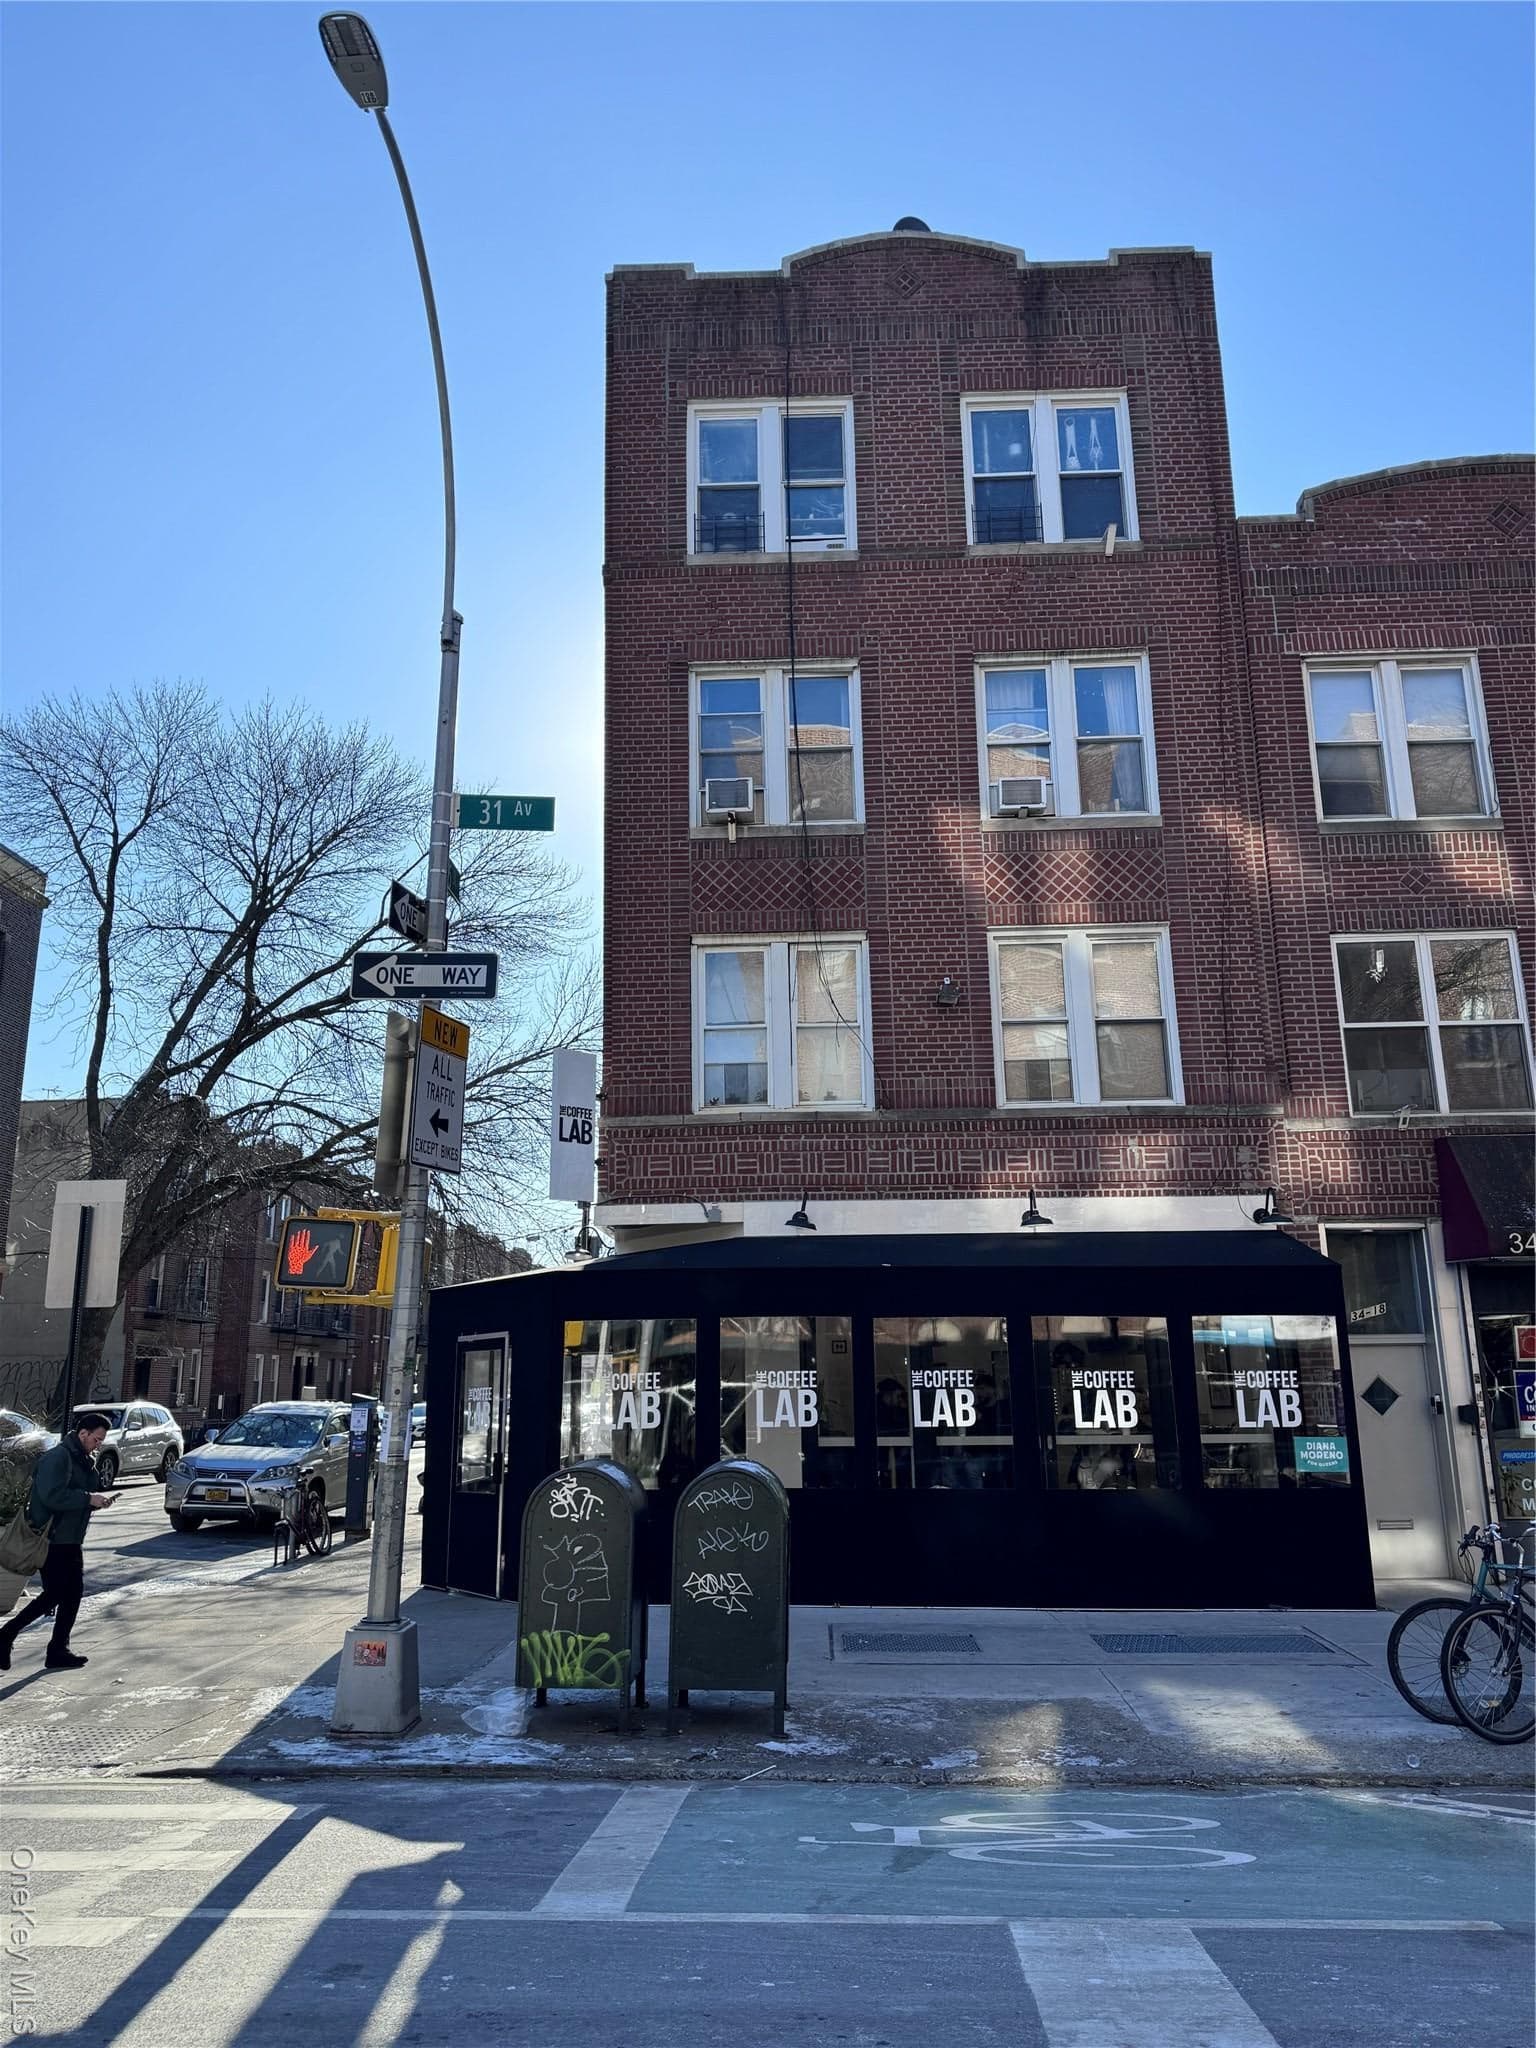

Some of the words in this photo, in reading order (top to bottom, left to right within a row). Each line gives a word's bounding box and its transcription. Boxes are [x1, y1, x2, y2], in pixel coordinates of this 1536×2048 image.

[480, 799, 502, 825] 31
[401, 902, 417, 928] ONE
[377, 967, 414, 985] ONE
[442, 967, 481, 985] WAY
[434, 1019, 458, 1049] NEW
[432, 1054, 453, 1082] ALL
[426, 1080, 456, 1108] TRAFFIC
[567, 1106, 592, 1120] COFFEE
[559, 1117, 592, 1145] LAB
[415, 1137, 439, 1158] EXCEPT
[441, 1145, 459, 1162] BIKES
[1509, 1232, 1536, 1253] 34
[1352, 1304, 1385, 1321] 34-18
[612, 1371, 661, 1391] COFFEE
[756, 1370, 767, 1387] THE
[768, 1370, 817, 1388] COFFEE
[912, 1370, 923, 1387] THE
[924, 1370, 974, 1388] COFFEE
[1072, 1370, 1083, 1388] THE
[1084, 1370, 1135, 1388] COFFEE
[1234, 1370, 1246, 1388] THE
[1247, 1370, 1298, 1388] COFFEE
[756, 1389, 818, 1428] LAB
[913, 1389, 976, 1428] LAB
[1073, 1389, 1138, 1428] LAB
[1236, 1389, 1302, 1428] LAB
[1300, 1451, 1344, 1460] MORENO
[1306, 1442, 1336, 1450] DIANA
